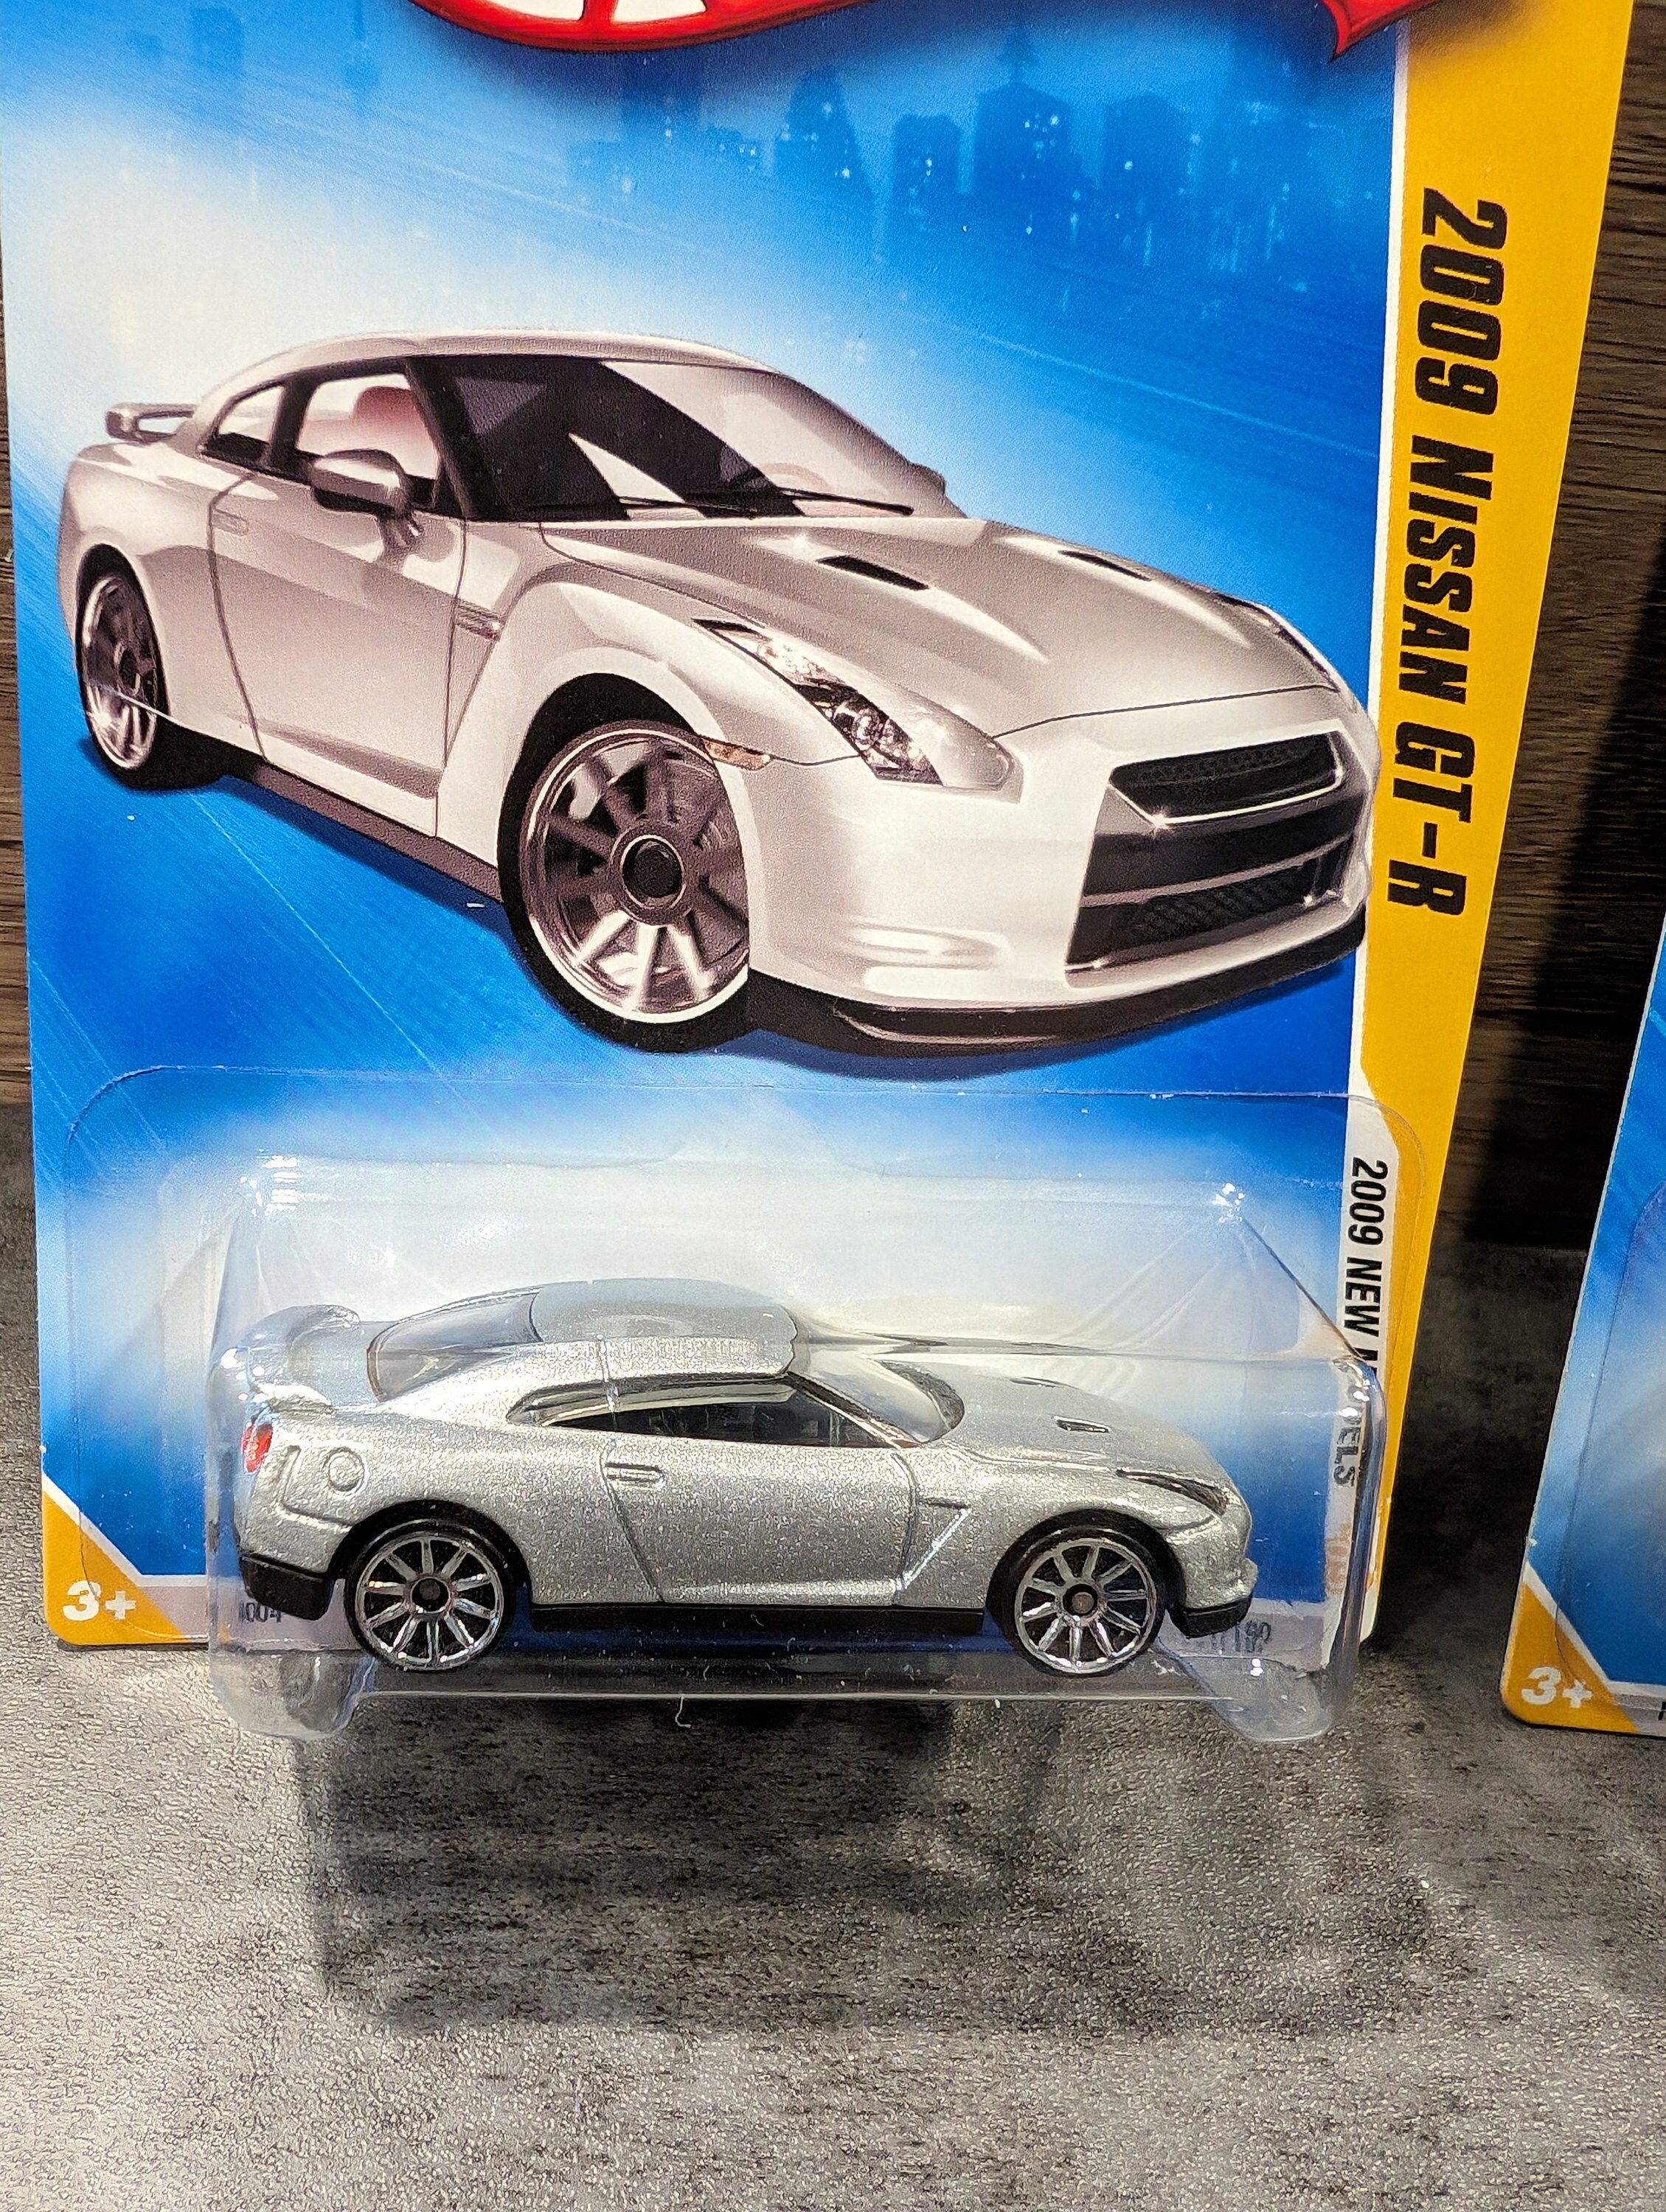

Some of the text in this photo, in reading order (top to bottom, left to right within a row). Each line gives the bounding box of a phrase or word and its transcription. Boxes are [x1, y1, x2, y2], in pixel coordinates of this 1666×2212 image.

[1388, 188, 1507, 916] 2009 NISSAN GT-R
[1348, 1157, 1388, 1245] 2009
[1344, 1256, 1383, 1338] NEW
[62, 1579, 136, 1621] 3+
[1521, 1666, 1593, 1709] 3+
